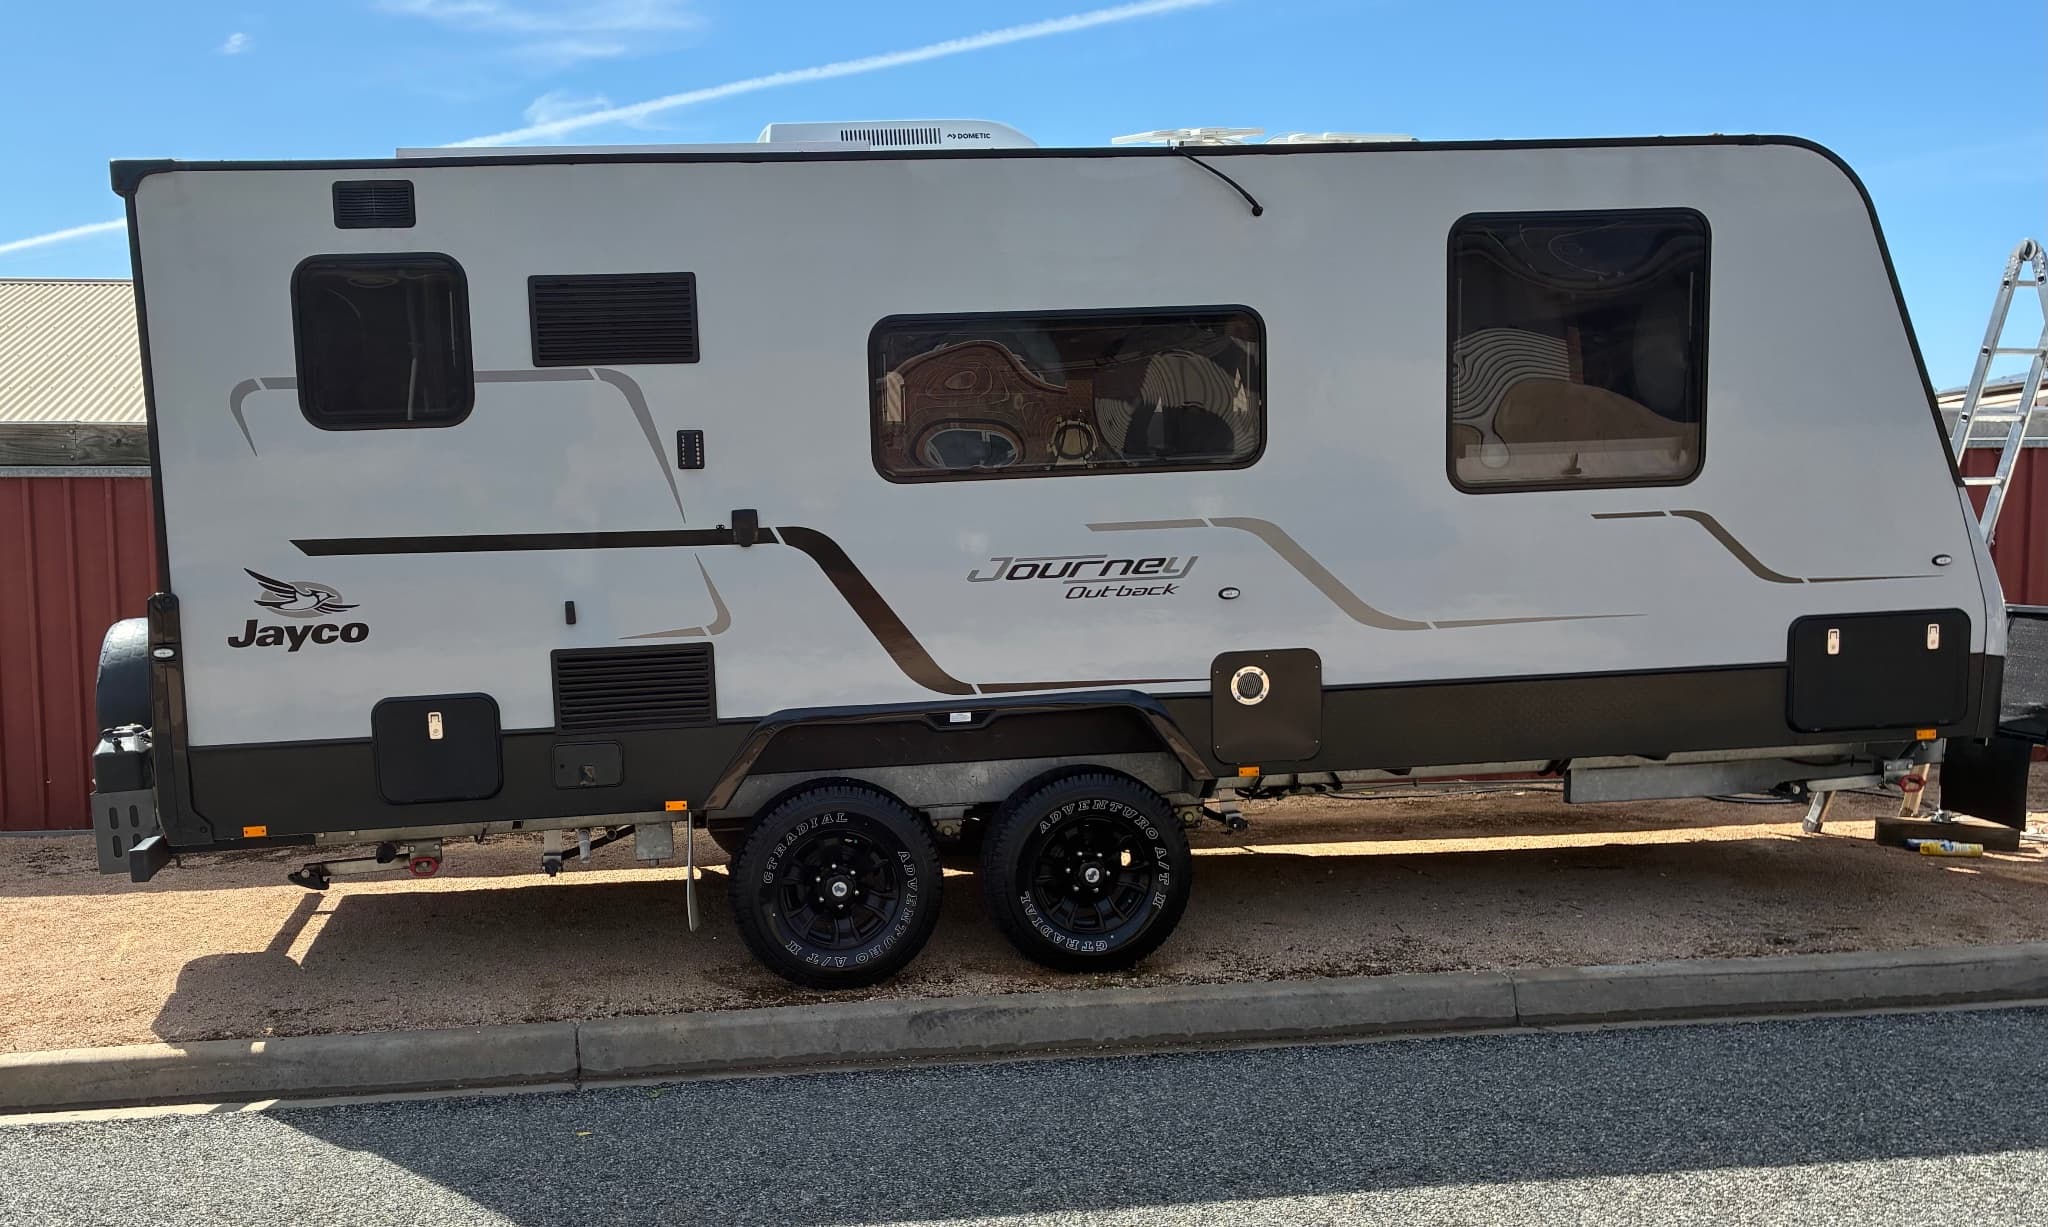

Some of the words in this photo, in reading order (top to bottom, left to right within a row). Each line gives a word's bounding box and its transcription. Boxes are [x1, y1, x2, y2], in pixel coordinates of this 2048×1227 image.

[957, 131, 992, 140] DOMETIC
[967, 554, 1199, 584] Journey
[1065, 583, 1180, 600] Outback
[227, 619, 370, 653] Jayco
[1039, 799, 1159, 840] ADVENTURO
[855, 850, 918, 964] ADVENTURO
